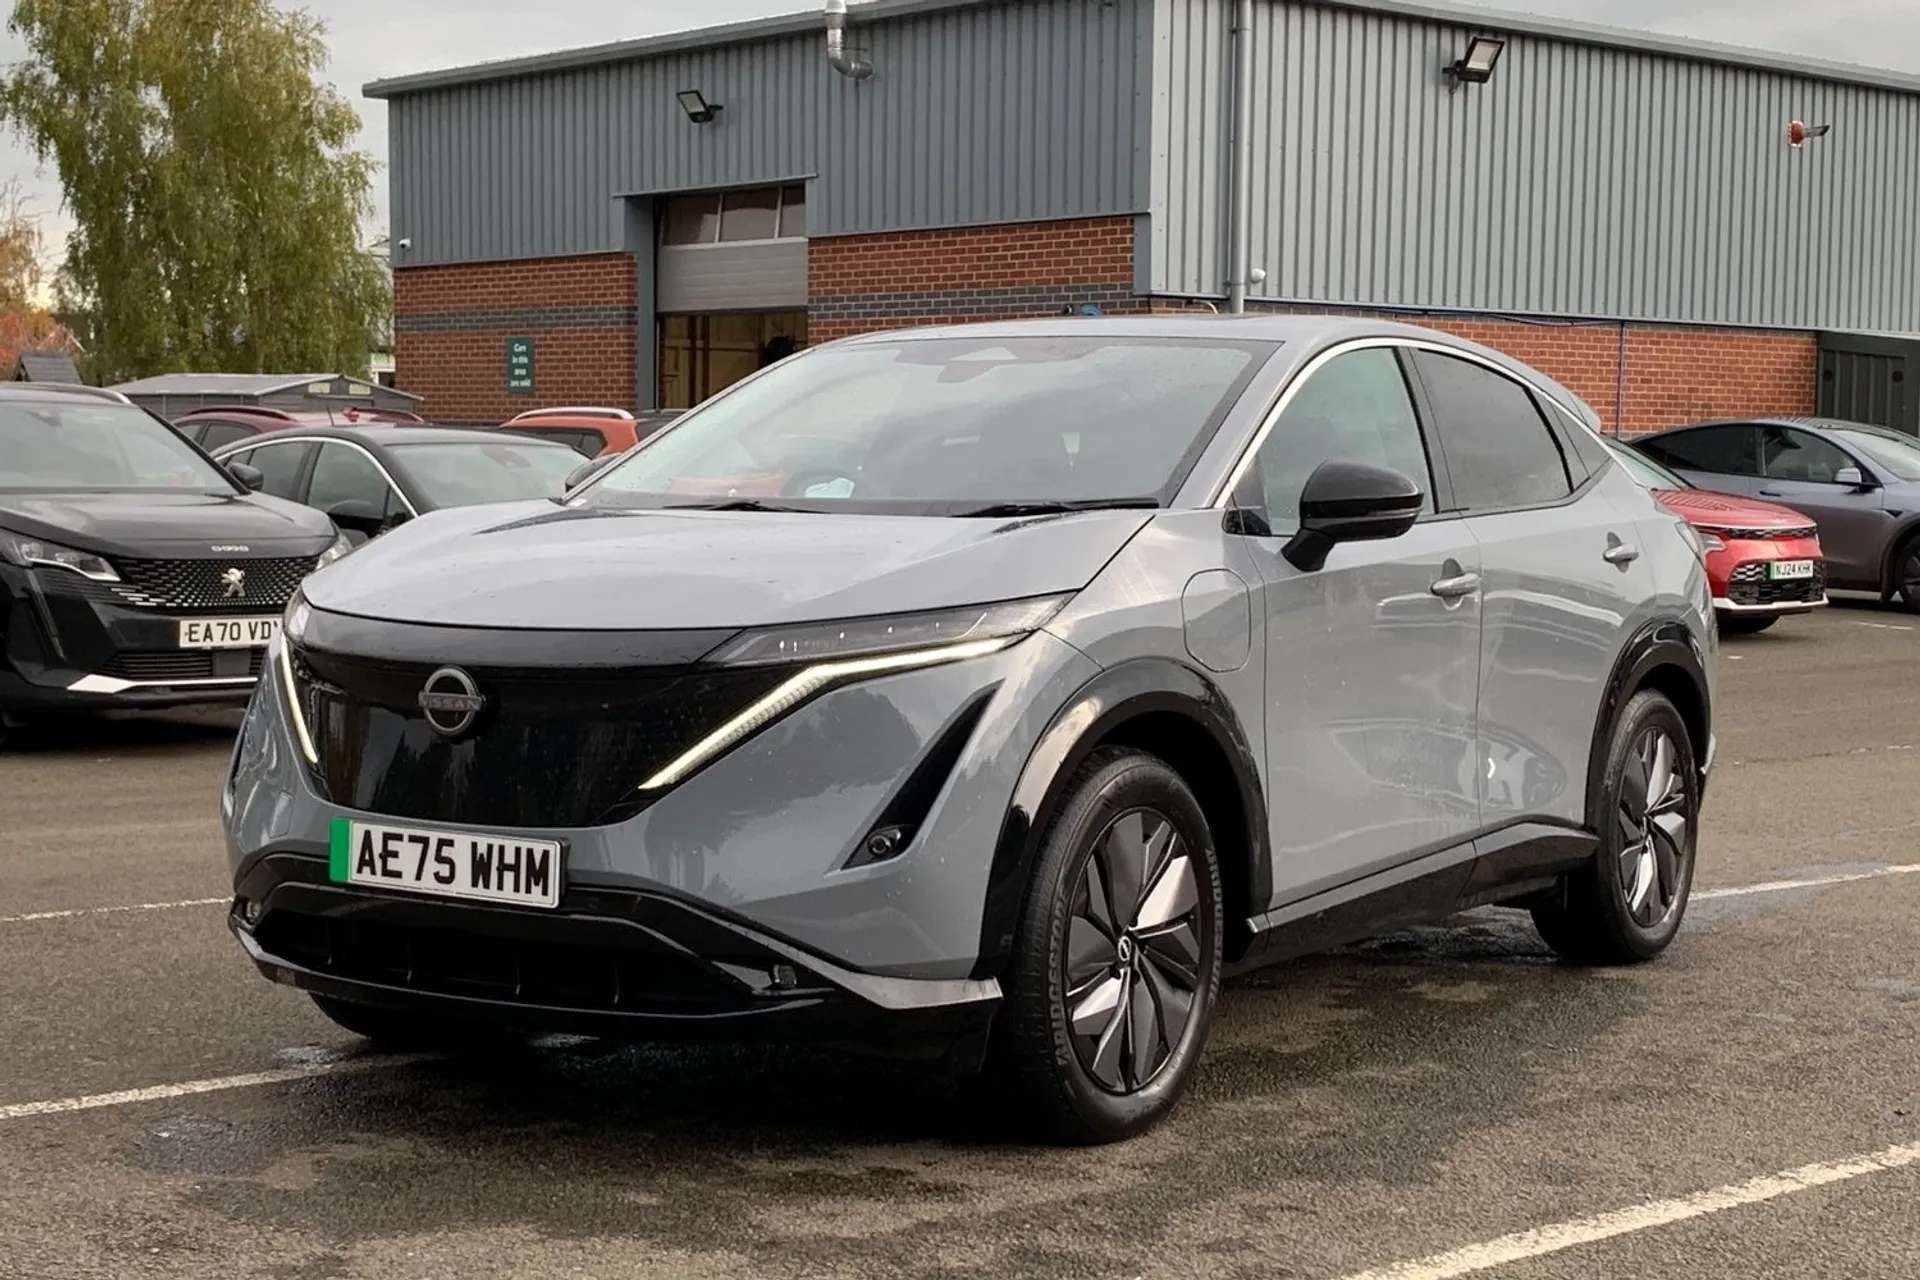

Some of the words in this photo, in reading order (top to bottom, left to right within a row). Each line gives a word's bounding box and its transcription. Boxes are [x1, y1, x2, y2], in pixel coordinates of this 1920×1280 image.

[188, 622, 241, 642] EA70
[419, 692, 480, 710] NISSAN
[355, 829, 456, 885] AE75
[470, 841, 550, 896] WHM
